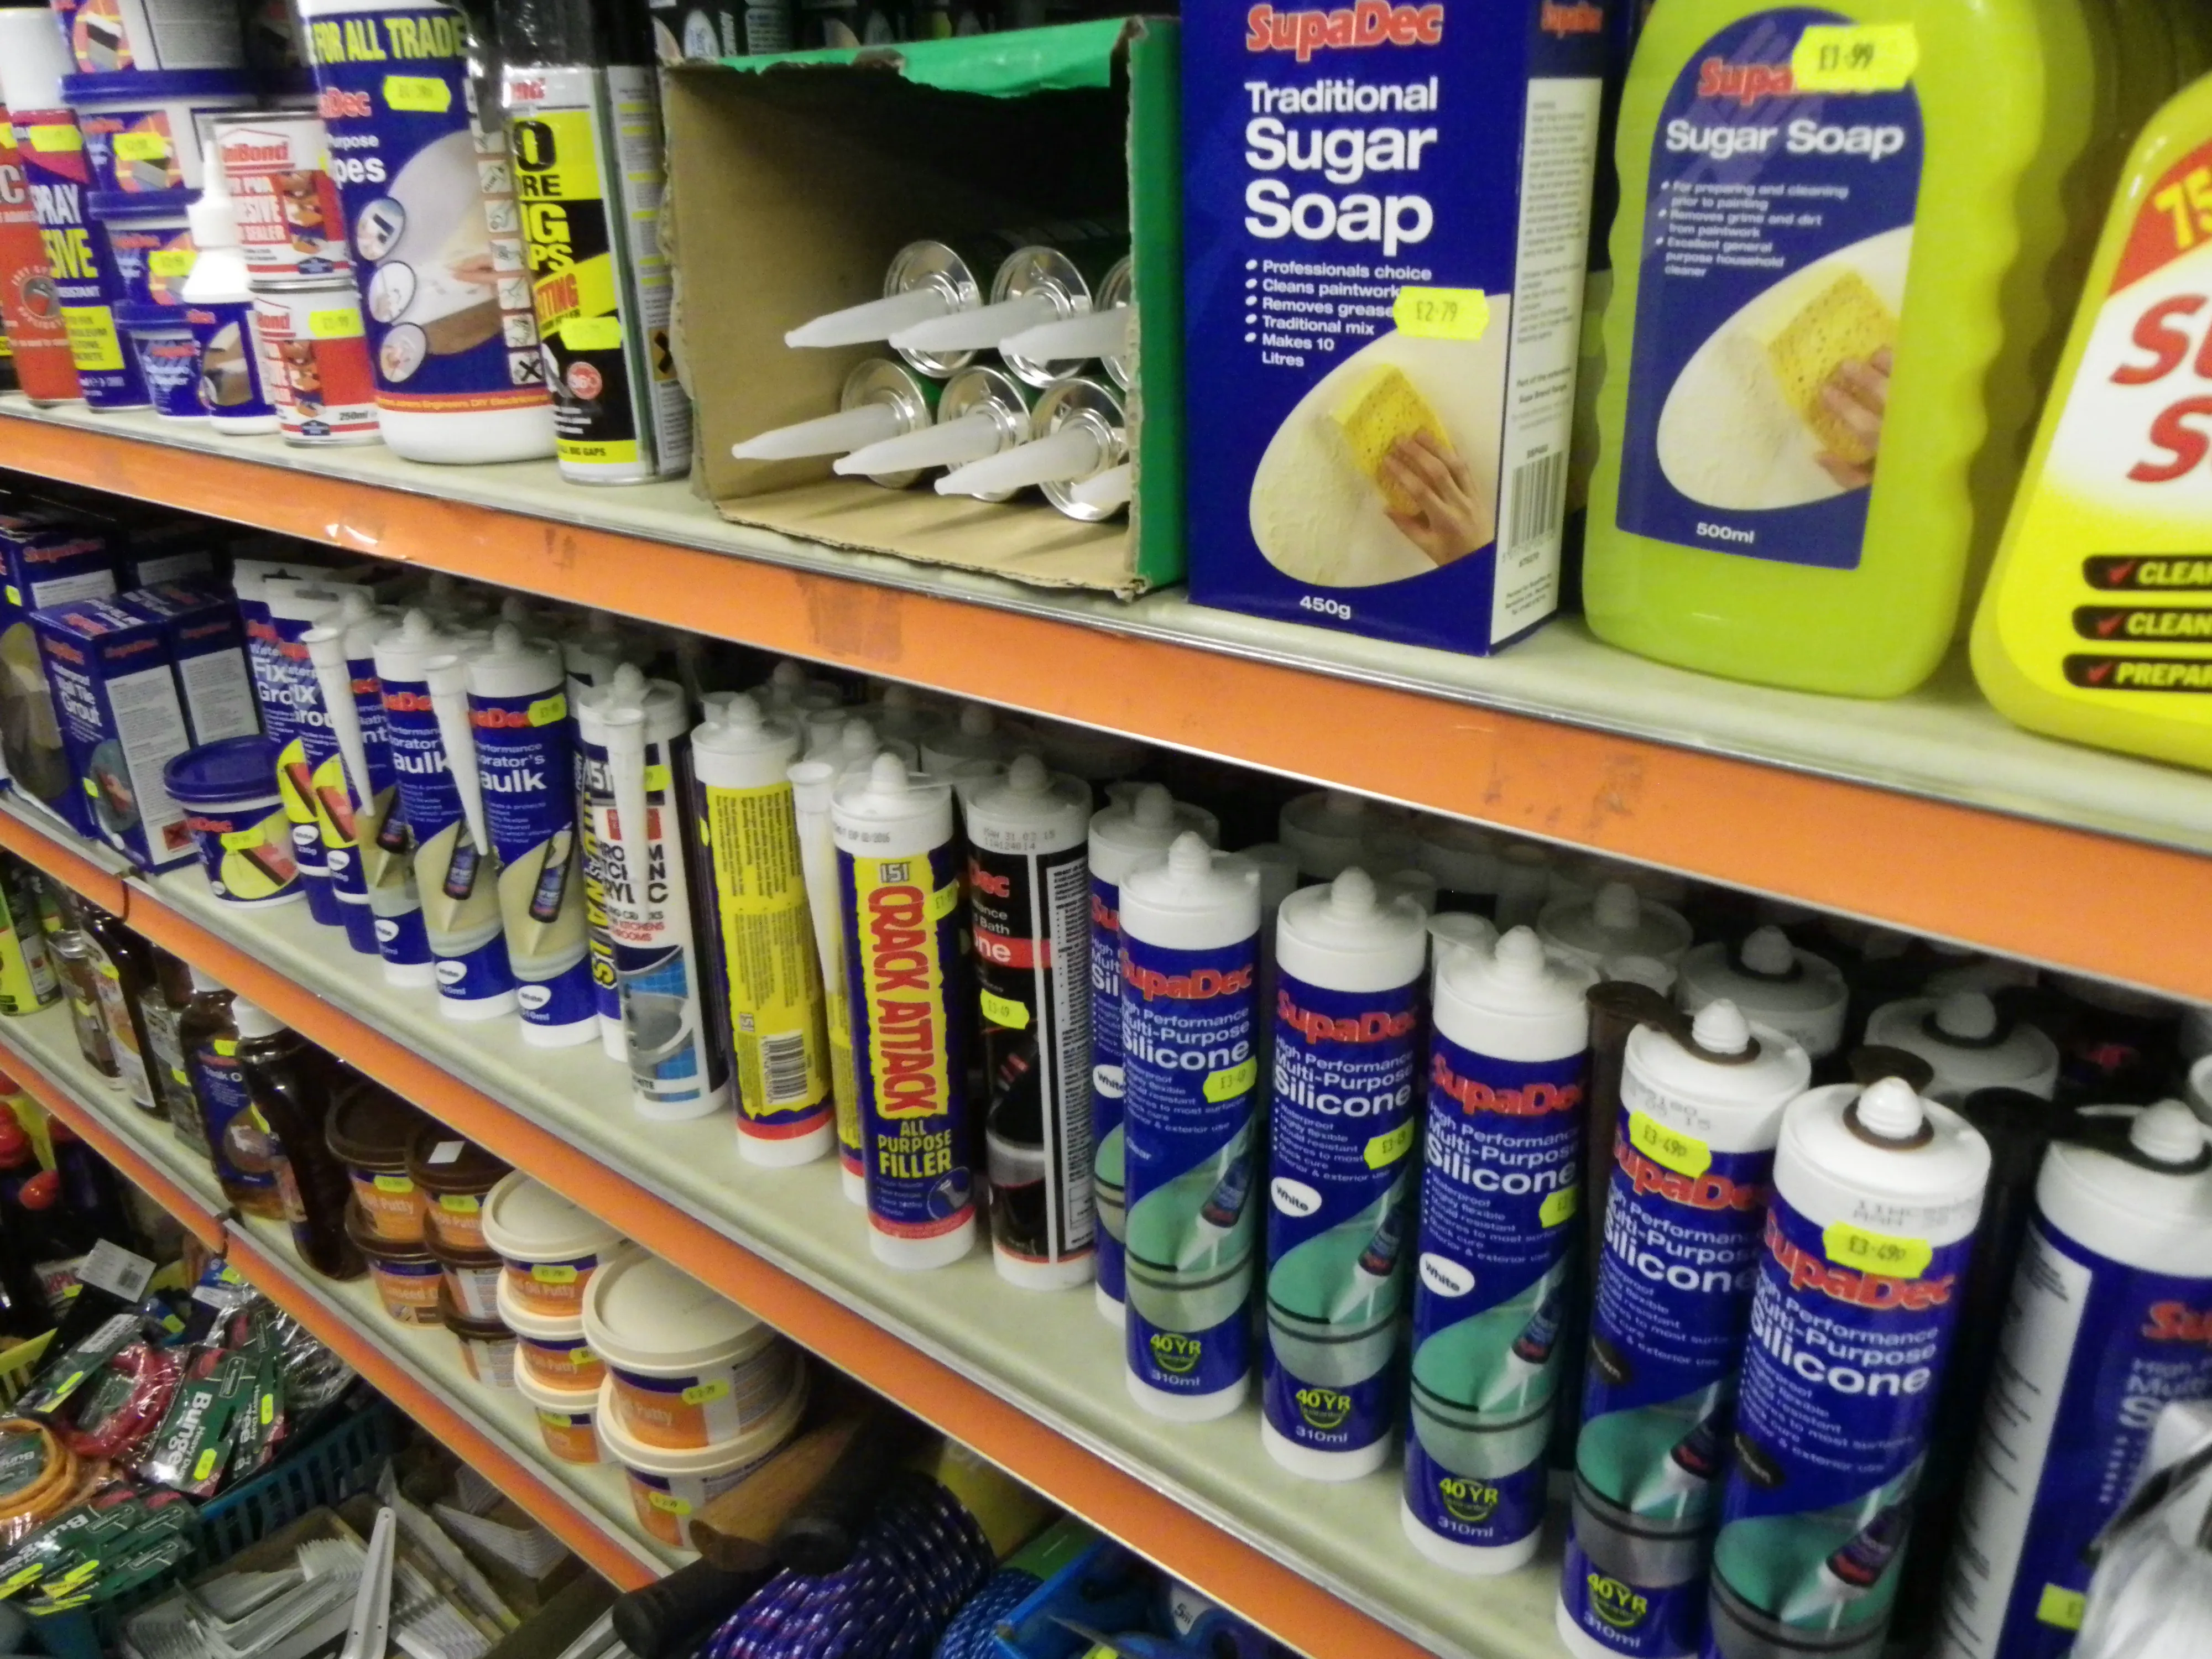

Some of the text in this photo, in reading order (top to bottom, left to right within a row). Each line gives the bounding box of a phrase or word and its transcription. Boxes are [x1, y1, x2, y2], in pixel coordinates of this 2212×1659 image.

[345, 19, 386, 61] ALL
[1246, 1, 1443, 62] SupaDec
[1244, 76, 1437, 113] Traditional
[1245, 117, 1437, 183] Sugar
[1666, 119, 1904, 162] Sugar Soap
[1758, 184, 1784, 196] and
[1787, 184, 1849, 200] cleaning
[1702, 197, 1714, 208] to
[1717, 199, 1768, 211] painting
[1245, 179, 1433, 257] Soap
[1768, 213, 1795, 225] and
[1798, 214, 1822, 226] dirt
[1262, 260, 1432, 281] Professionals choice
[1262, 279, 1401, 299] Cleans paintwork
[1262, 298, 1333, 314] Removes
[1262, 315, 1375, 336] Traditional mix
[1262, 333, 1334, 351] Makes 10
[1262, 351, 1305, 367] Litres
[583, 447, 606, 456] GAPS
[1696, 521, 1755, 544] 500ml
[1299, 595, 1352, 619] 450g
[479, 769, 547, 793] aulk
[880, 863, 910, 883] 151
[979, 915, 1010, 936] Bath
[868, 885, 931, 993] CRACK
[1120, 948, 1254, 1002] SupaDec
[1123, 1010, 1249, 1047] Multi-Purpose
[1143, 1008, 1249, 1028] Performance
[877, 998, 938, 1114] ATTACK
[1123, 1022, 1249, 1071] Silicone
[1276, 1033, 1301, 1060] High
[1149, 1092, 1196, 1105] resistant
[1274, 1065, 1411, 1118] Silicone
[1160, 1104, 1170, 1113] to
[1173, 1107, 1202, 1115] most
[1430, 1100, 1457, 1131] High
[900, 1119, 927, 1137] ALL
[1307, 1128, 1348, 1142] flexible
[878, 1129, 952, 1154] PURPOSE
[1307, 1138, 1358, 1153] resistant
[879, 1147, 952, 1178] FILLER
[1304, 1157, 1329, 1170] cure
[1319, 1151, 1331, 1160] to
[1427, 1133, 1576, 1195] Silicone
[1323, 1171, 1369, 1182] exterior
[380, 1198, 414, 1214] Putty
[1276, 1184, 1309, 1212] White
[1461, 1215, 1516, 1232] resistant
[1473, 1229, 1486, 1239] to
[1425, 1260, 1460, 1293] White
[545, 1283, 576, 1298] Putty
[1786, 1297, 1939, 1347] Performance
[1152, 1369, 1201, 1387] 310ml
[1296, 1425, 1348, 1443] 310ml
[1438, 1516, 1494, 1538] 310ml
[1583, 1610, 1641, 1648] 310ml
